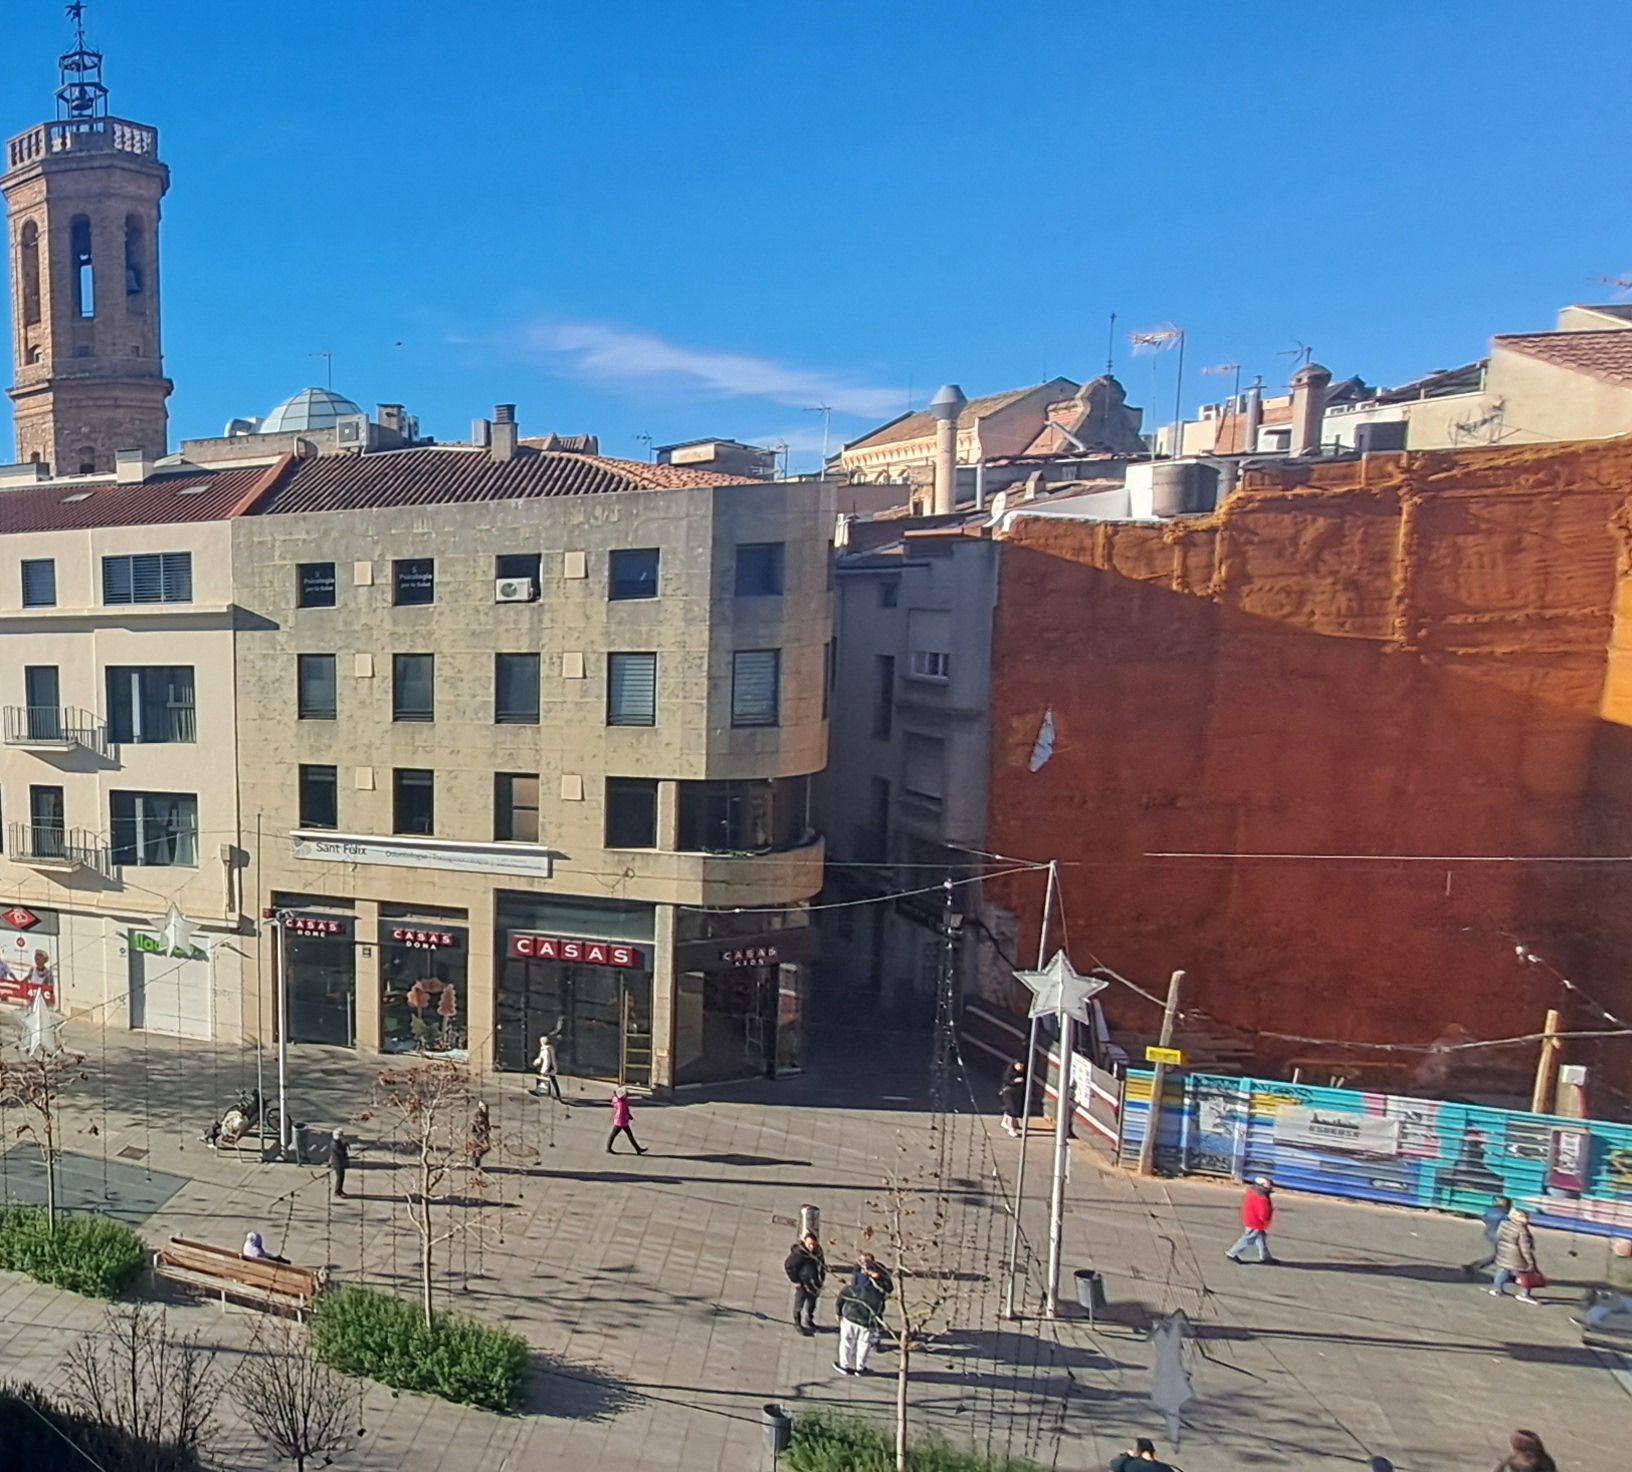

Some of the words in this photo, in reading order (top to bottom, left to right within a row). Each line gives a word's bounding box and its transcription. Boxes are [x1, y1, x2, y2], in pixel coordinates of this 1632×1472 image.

[316, 841, 341, 854] Sant
[285, 919, 337, 932] CASAS
[393, 930, 450, 944] CASAS
[406, 940, 437, 950] DONA
[517, 939, 628, 963] CASAS
[723, 947, 776, 960] CASAS
